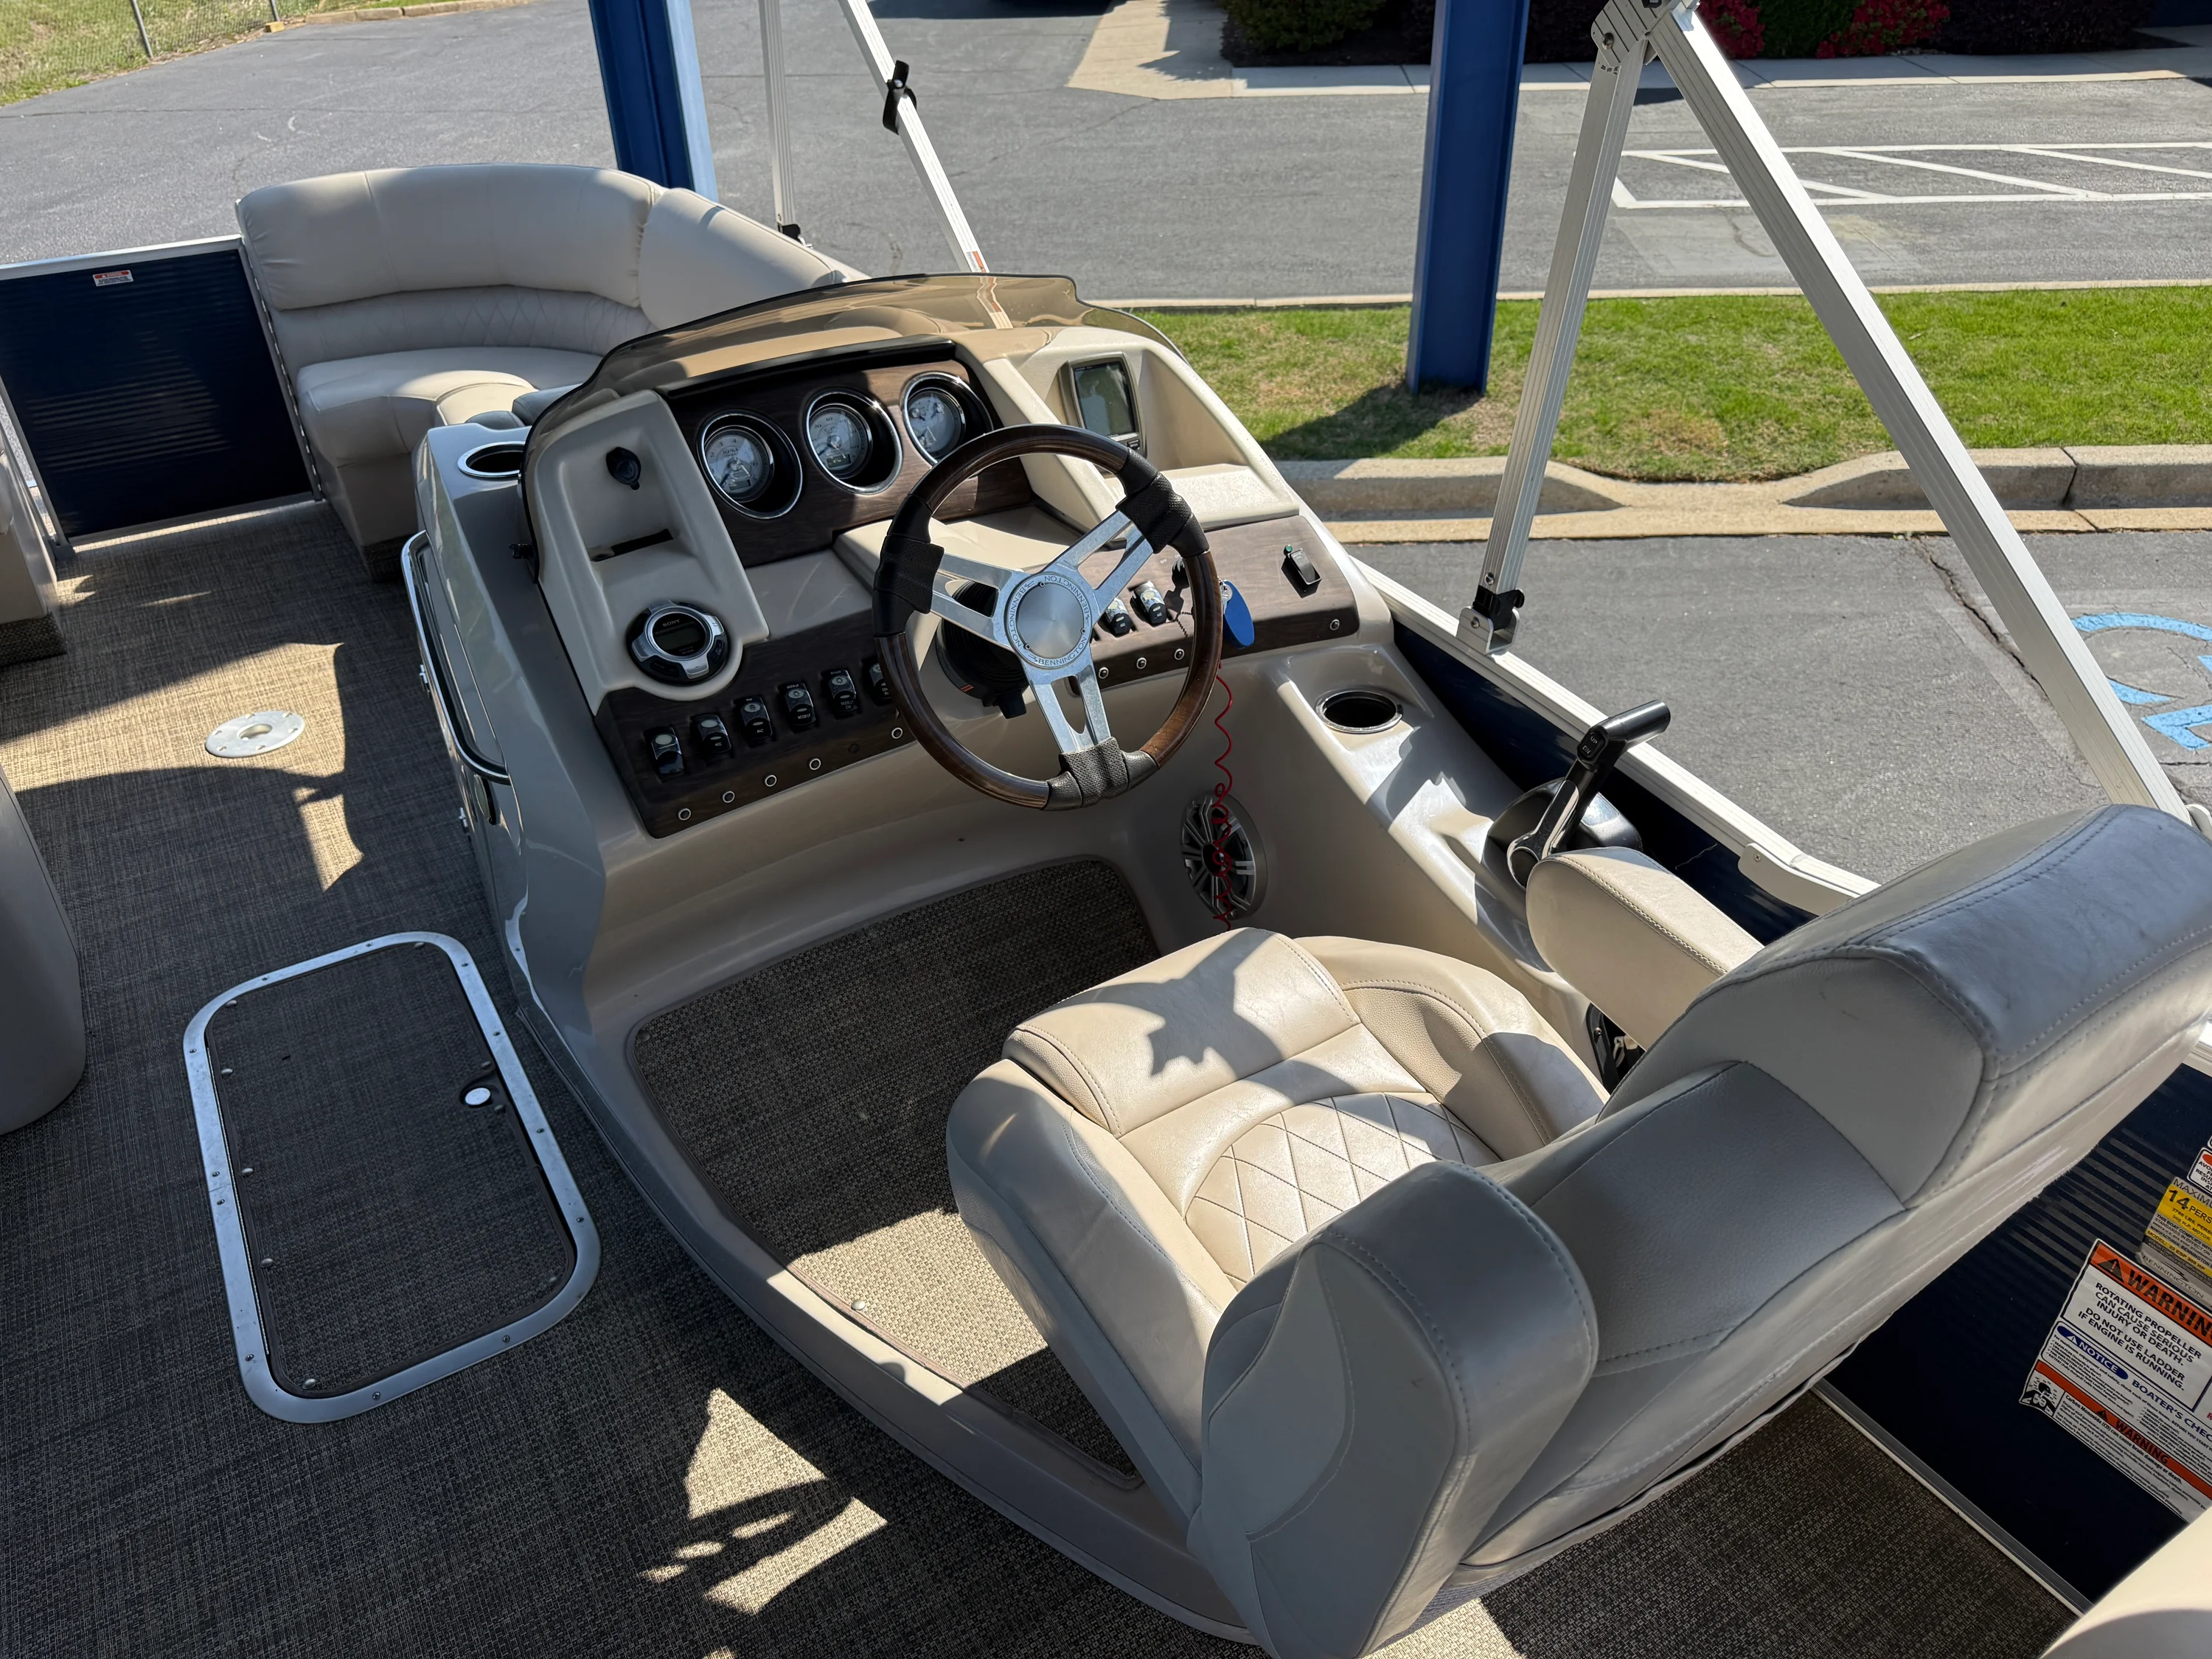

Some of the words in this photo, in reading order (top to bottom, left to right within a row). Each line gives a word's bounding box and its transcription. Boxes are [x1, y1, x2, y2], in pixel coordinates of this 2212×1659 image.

[1044, 575, 1090, 616] BENNINGTON
[662, 619, 680, 627] SONY
[1009, 587, 1026, 647] BENNINGTON
[1038, 636, 1087, 666] BENNINGTON
[1582, 745, 1591, 754] DN
[1590, 736, 1598, 744] UP
[2168, 1189, 2190, 1211] 14
[2146, 1230, 2167, 1245] MODEL:
[2154, 1217, 2180, 1236] STANDARDS
[2185, 1237, 2203, 1251] EFFECT
[2156, 1213, 2166, 1222] THIS
[2166, 1220, 2179, 1230] BOAT
[2178, 1228, 2202, 1245] COMPLIES
[2191, 1226, 2211, 1241] MOTOR
[2142, 1254, 2205, 1298] BENNINGTON
[2180, 1245, 2210, 1266] BENNINGTON
[2094, 1281, 2143, 1318] ROTATING
[2143, 1315, 2202, 1359] PROPELLER
[2094, 1290, 2116, 1309] CAN
[2116, 1305, 2152, 1334] CAUSE
[2149, 1329, 2194, 1363] SERIOUS
[2096, 1300, 2132, 1328] INJURY
[2131, 1324, 2148, 1340] OR
[2147, 1336, 2185, 1366] DEATH.
[2077, 1310, 2087, 1321] IF
[2087, 1318, 2124, 1347] ENGINE
[2124, 1343, 2135, 1354] IS
[2135, 1351, 2186, 1391] RUNNING.
[2084, 1307, 2101, 1321] DO
[2101, 1318, 2124, 1338] NOT
[2123, 1334, 2143, 1352] USE
[2143, 1349, 2185, 1381] LADDER
[2059, 1338, 2079, 1354] maximum
[2078, 1352, 2099, 1370] enjoyment
[2098, 1367, 2107, 1375] and
[2107, 1373, 2121, 1385] safety,
[2120, 1382, 2132, 1393] check
[2171, 1419, 2187, 1433] BEFORE
[2186, 1430, 2197, 1439] YOU
[2195, 1436, 2208, 1448] START
[2078, 1340, 2118, 1374] NOTICE
[2131, 1379, 2183, 1420] BOATER'S
[2065, 1394, 2081, 1408] Carbon
[2080, 1405, 2102, 1424] Monoxide
[2101, 1421, 2111, 1431] (CO)
[2110, 1428, 2119, 1437] can
[2118, 1434, 2132, 1447] cause
[2131, 1444, 2144, 1455] brain
[2143, 1453, 2163, 1470] damage
[2167, 1471, 2183, 1485] death.
[2114, 1419, 2170, 1465] WARNING
